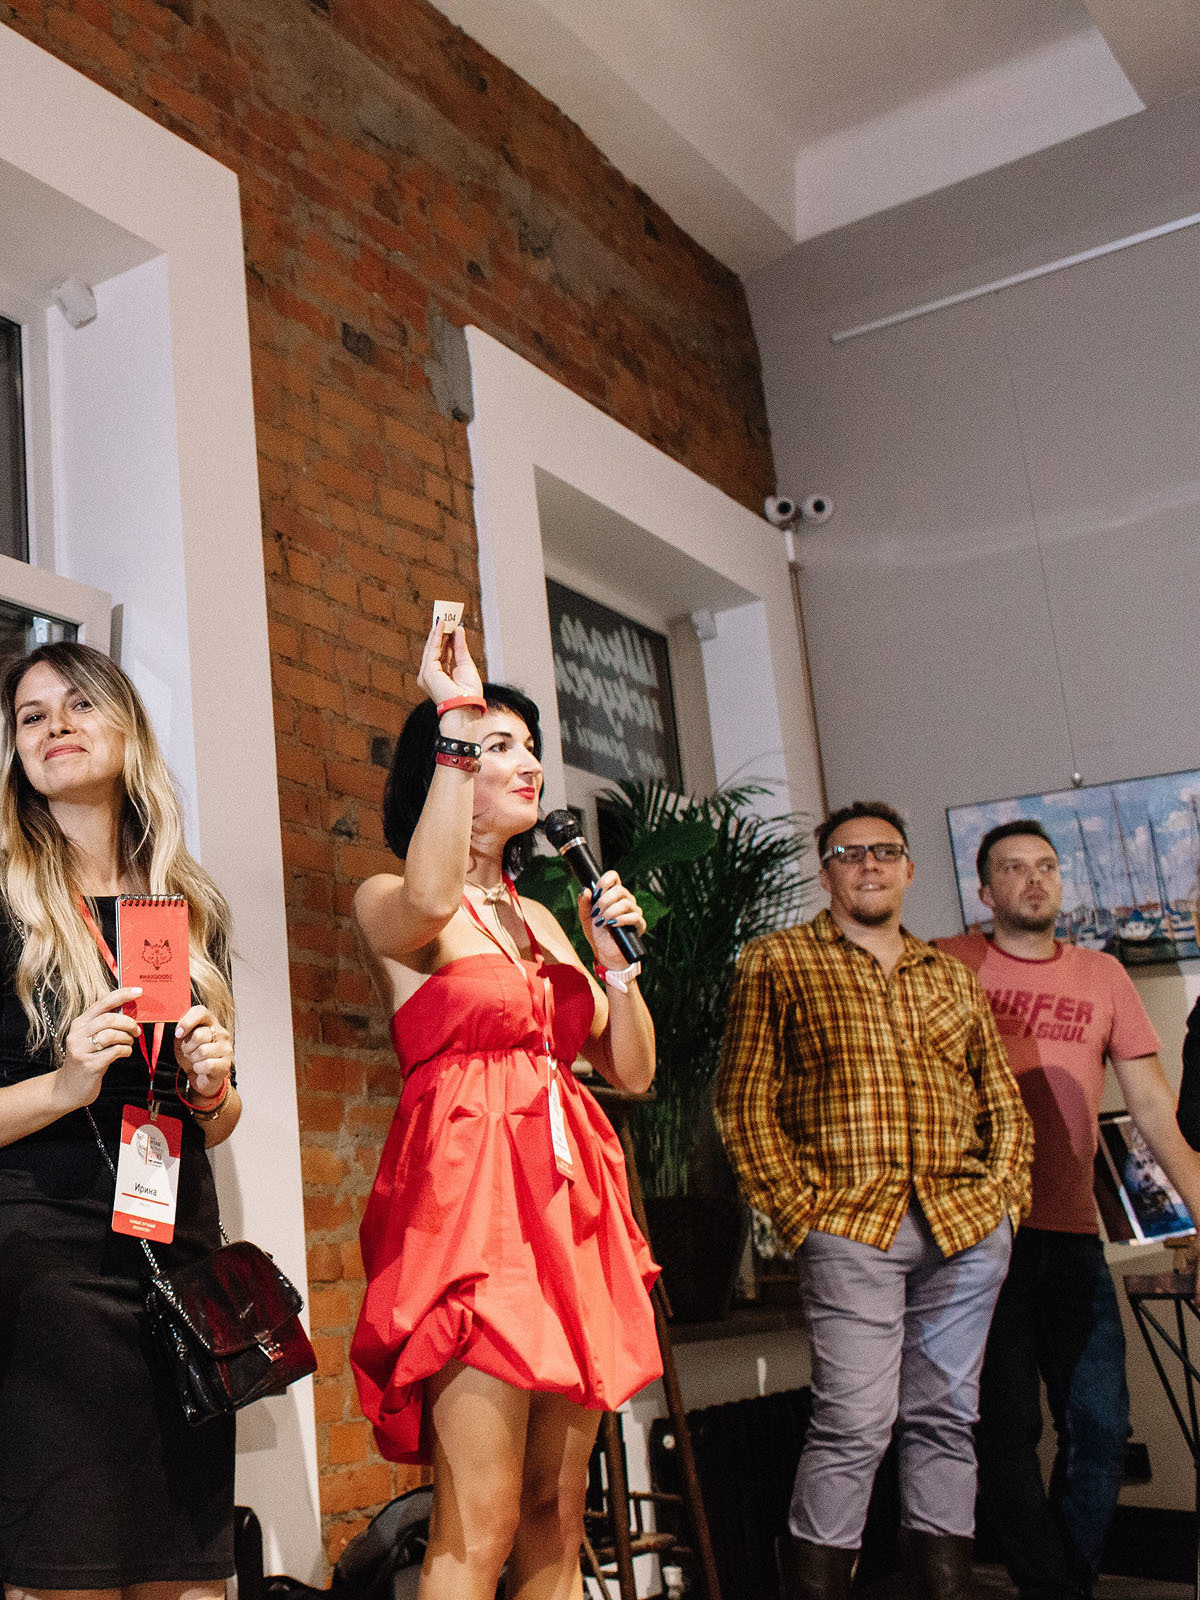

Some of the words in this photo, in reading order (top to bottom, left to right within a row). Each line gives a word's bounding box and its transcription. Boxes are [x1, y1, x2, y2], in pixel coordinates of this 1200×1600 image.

[443, 612, 456, 622] 104
[984, 988, 1094, 1038] URFER
[1036, 1022, 1088, 1043] SOUL
[134, 1182, 158, 1197] Ирина
